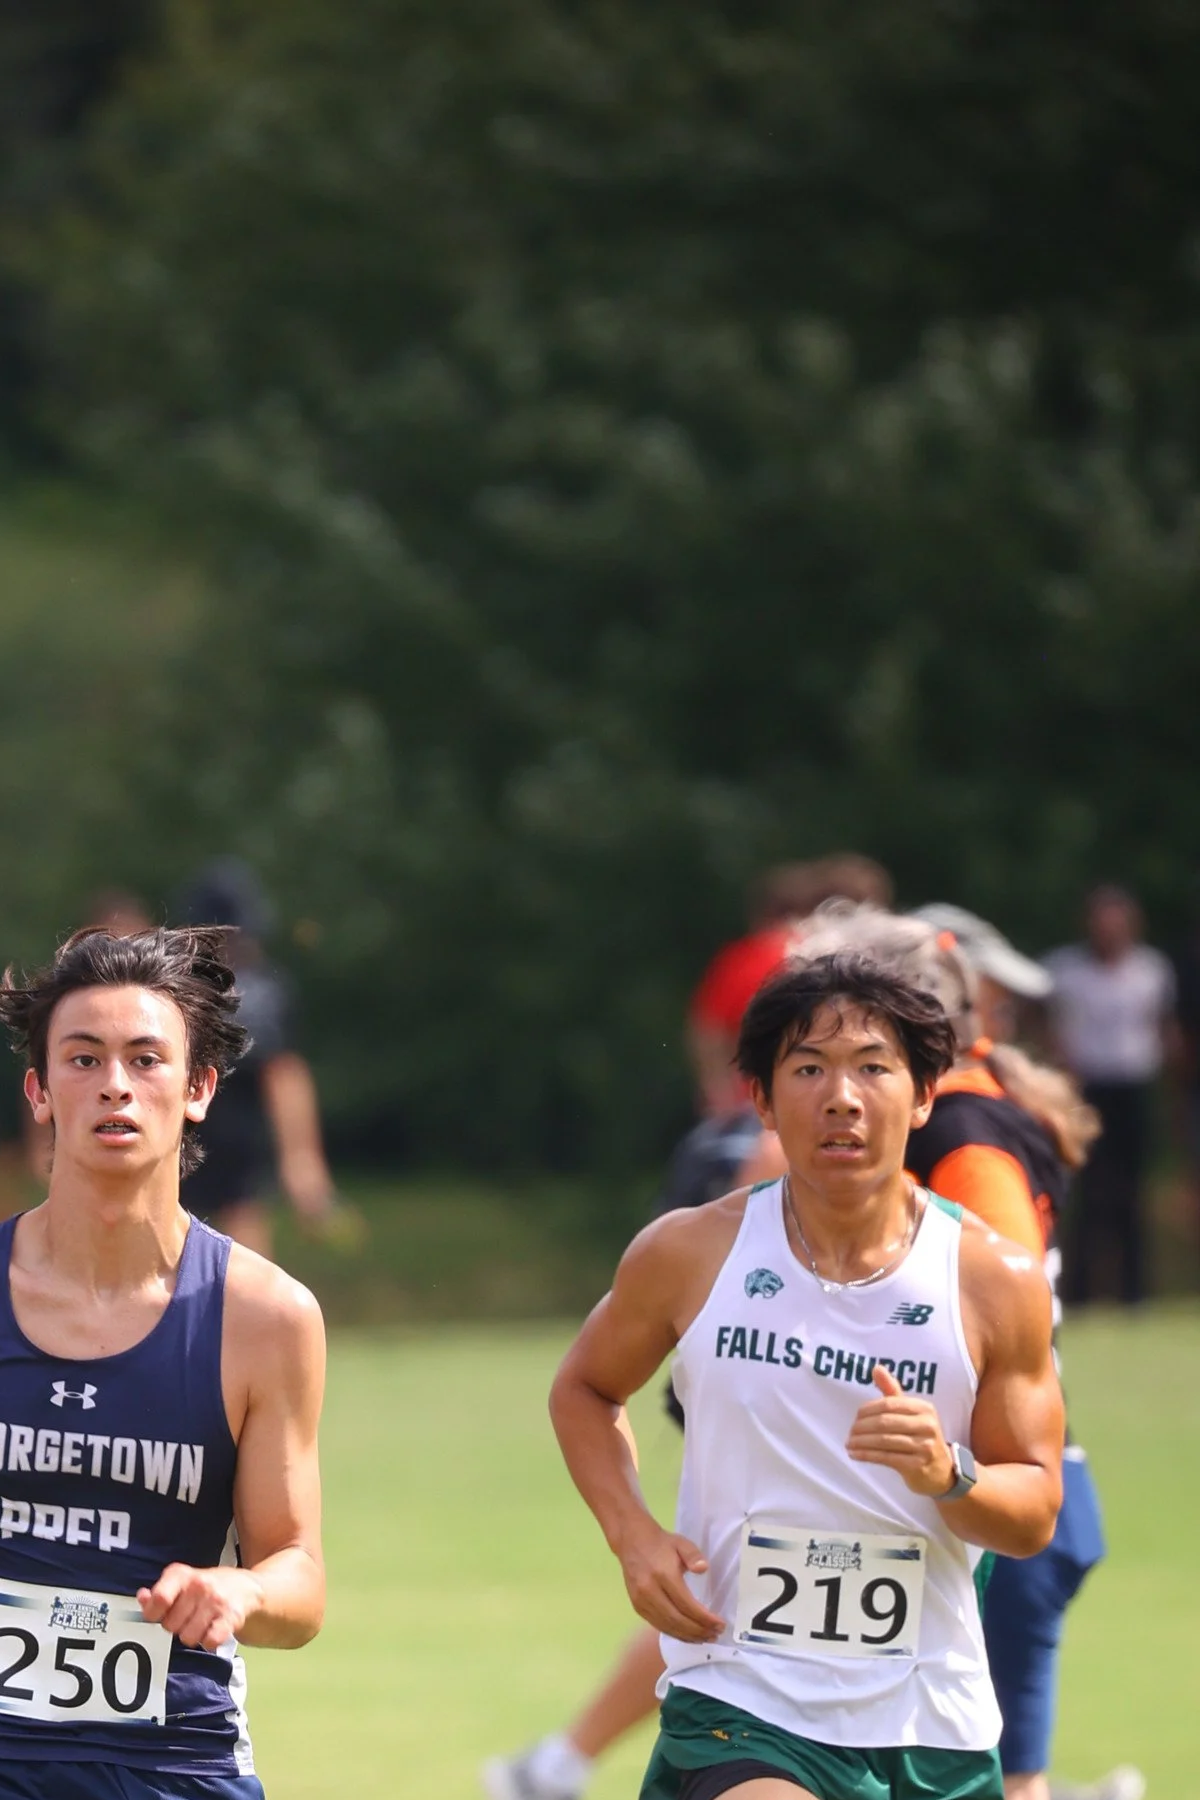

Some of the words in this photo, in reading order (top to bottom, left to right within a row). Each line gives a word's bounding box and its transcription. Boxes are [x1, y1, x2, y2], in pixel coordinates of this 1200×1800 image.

[715, 1326, 803, 1369] FALLS
[55, 1613, 102, 1629] CLASSIC
[750, 1566, 909, 1645] 219
